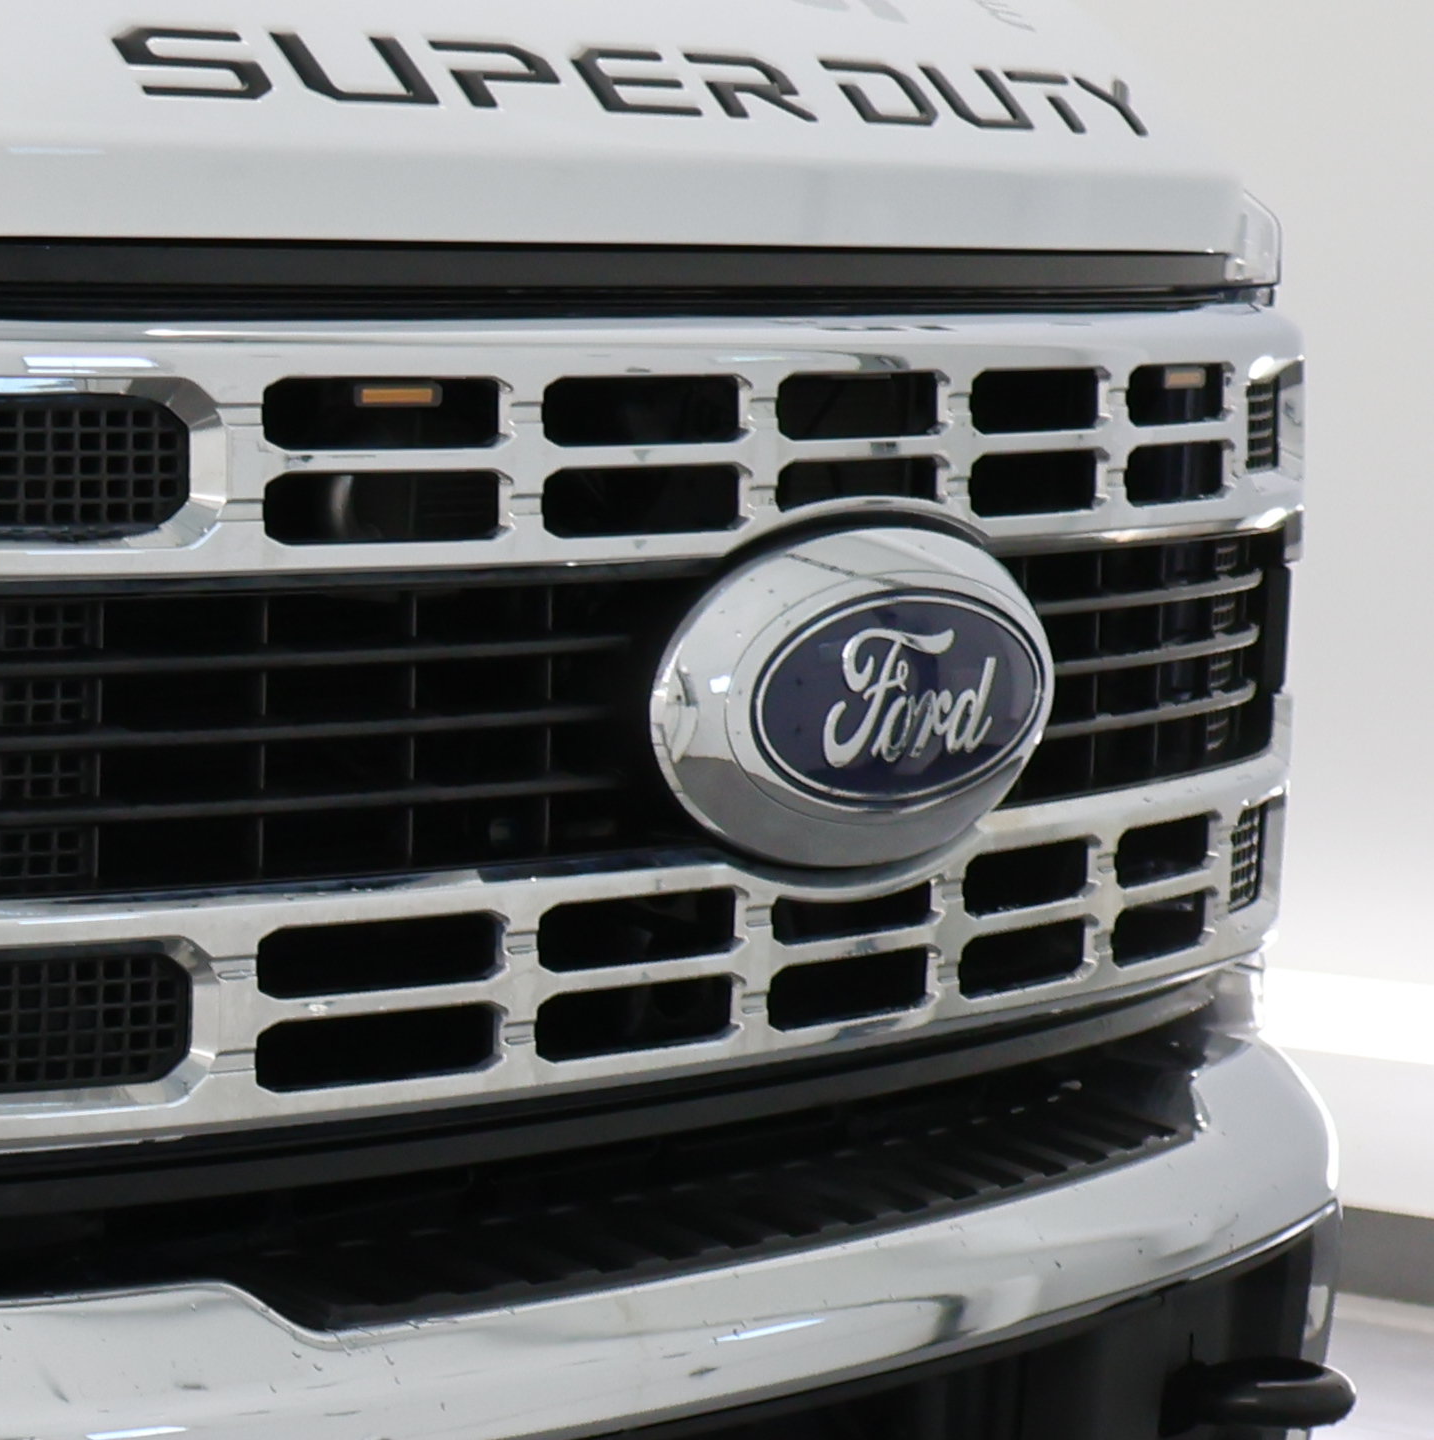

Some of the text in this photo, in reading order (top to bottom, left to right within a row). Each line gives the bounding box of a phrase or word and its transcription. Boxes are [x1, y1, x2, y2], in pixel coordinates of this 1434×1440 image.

[110, 25, 1149, 138] SUPER DUTY
[822, 627, 997, 769] Ford
